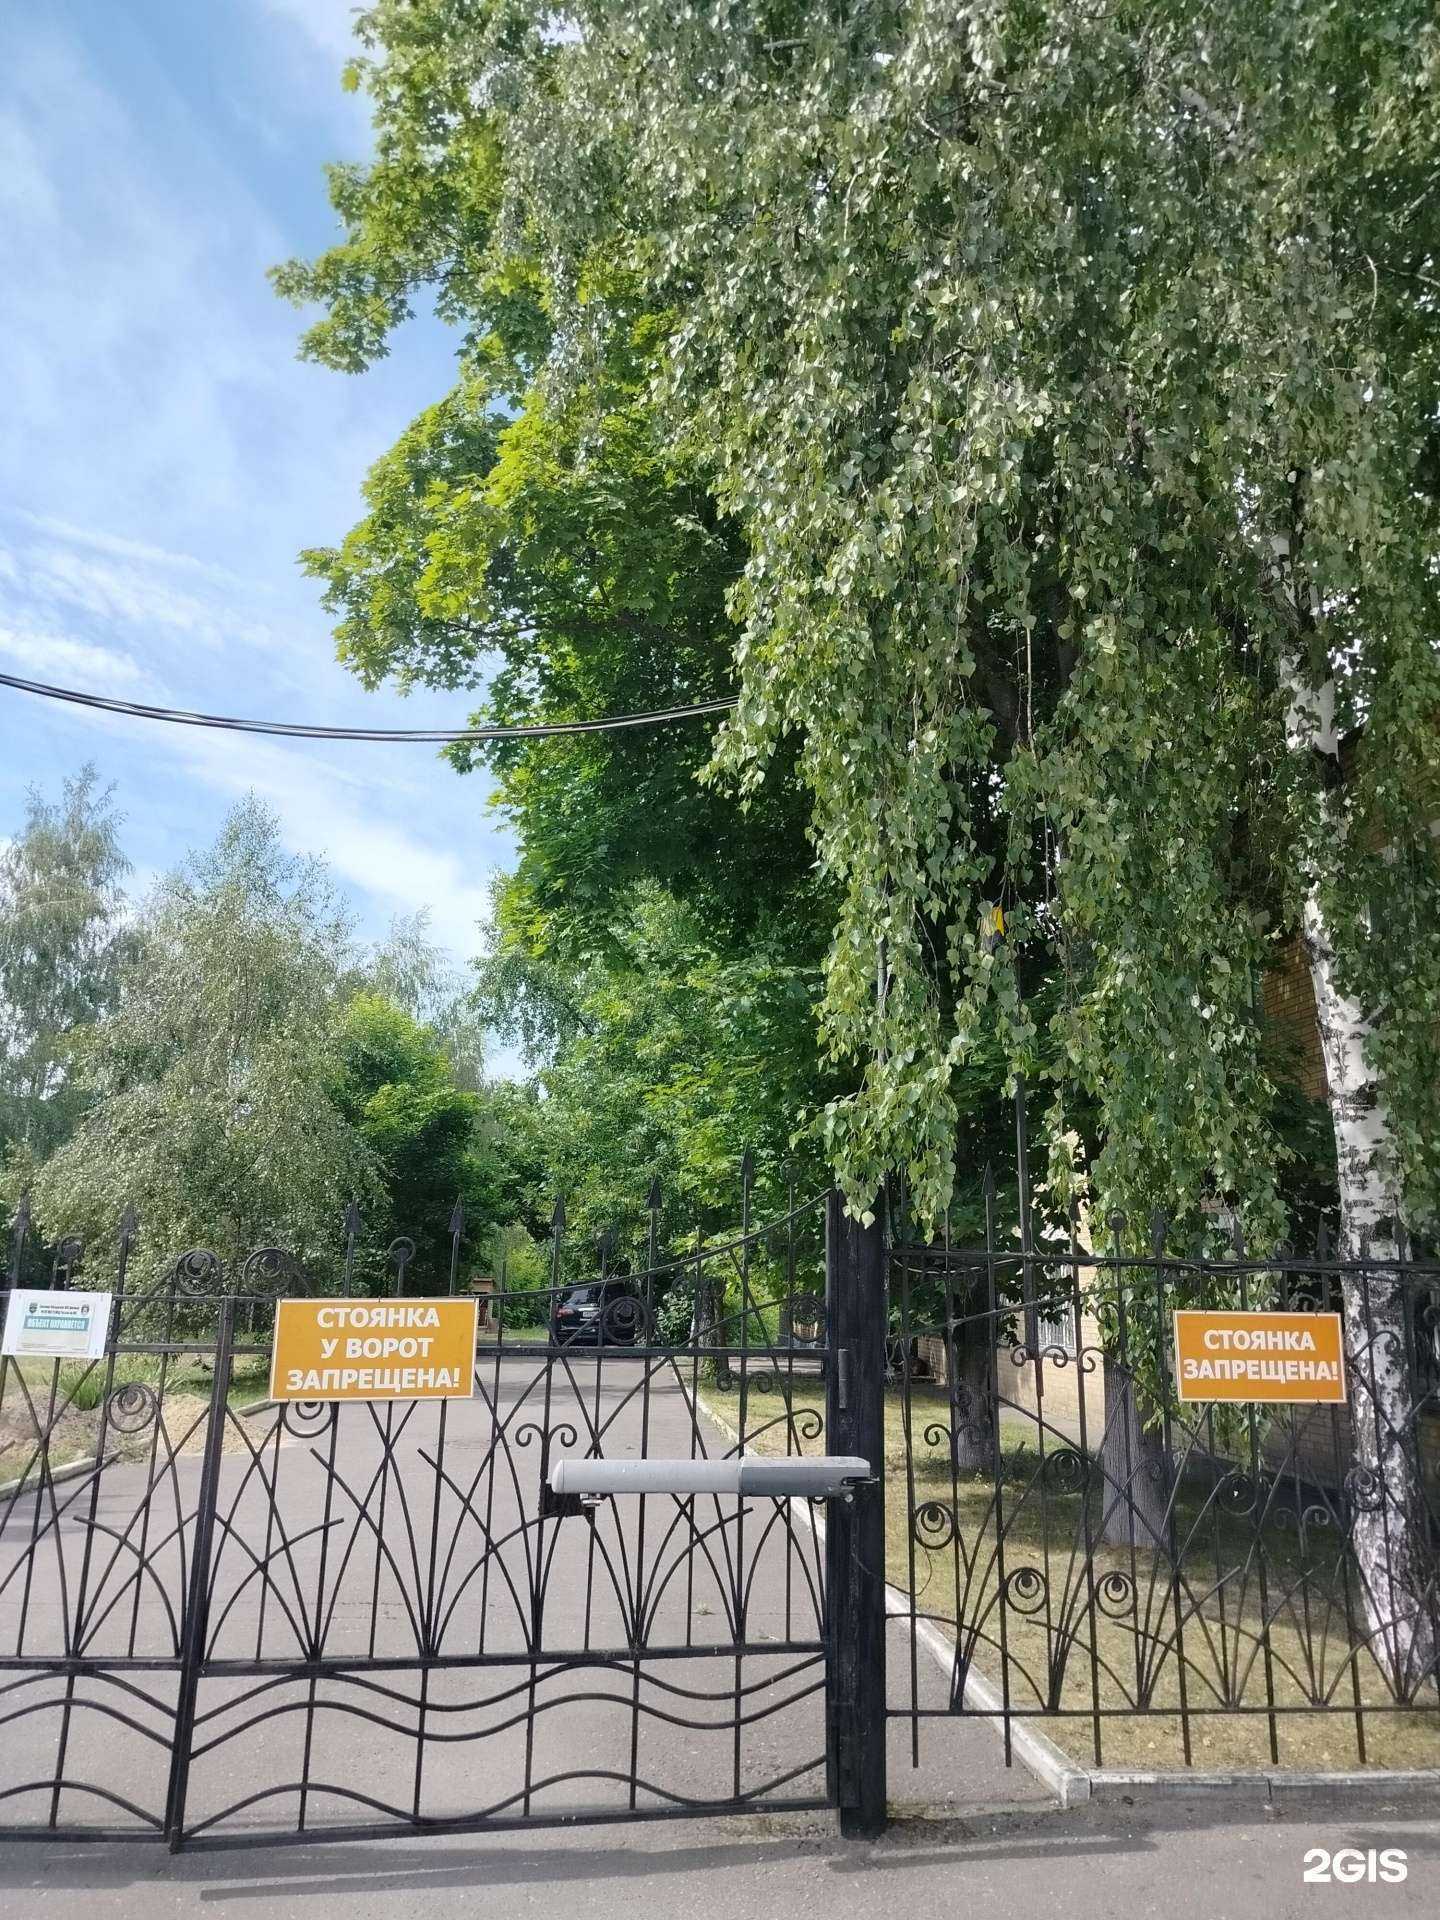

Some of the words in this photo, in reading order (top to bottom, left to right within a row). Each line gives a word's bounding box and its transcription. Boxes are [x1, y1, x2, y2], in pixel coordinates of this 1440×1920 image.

[317, 1307, 440, 1328] СТОЯНКА
[320, 1338, 339, 1359] У
[346, 1337, 434, 1359] ВОРОТ
[1204, 1329, 1316, 1351] СТОЯНКА
[286, 1367, 460, 1392] ЗАПРЕЩЕНА!
[1184, 1359, 1338, 1384] ЗАПРЕЩЕНА!
